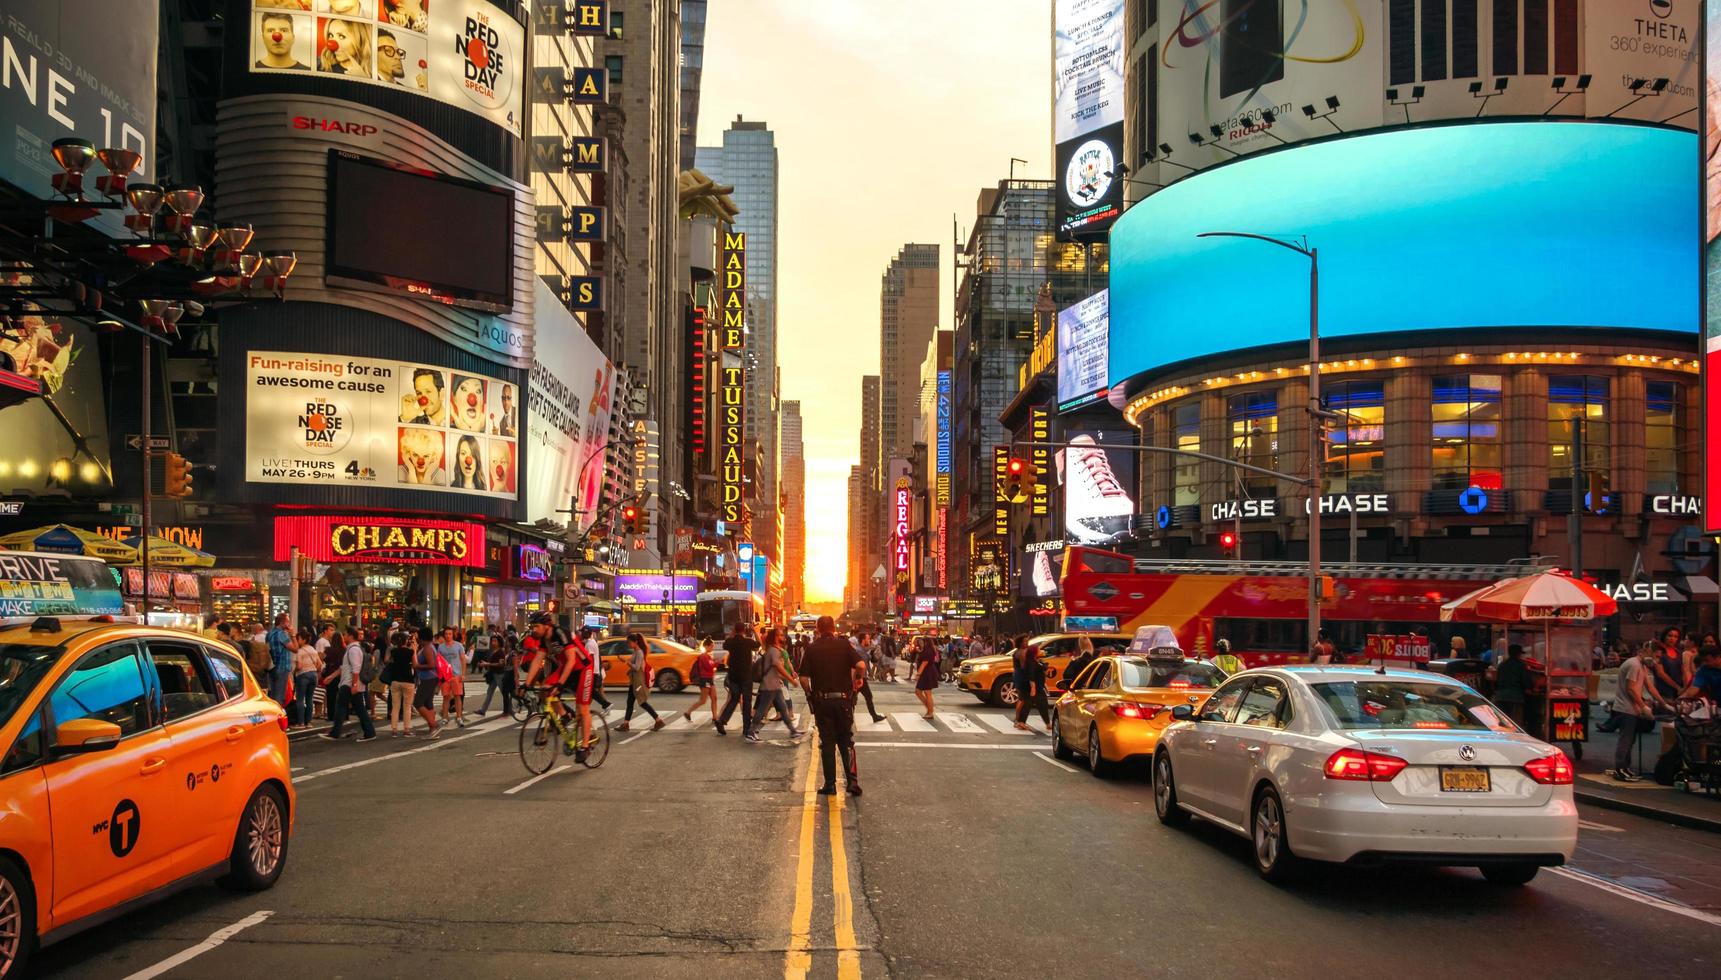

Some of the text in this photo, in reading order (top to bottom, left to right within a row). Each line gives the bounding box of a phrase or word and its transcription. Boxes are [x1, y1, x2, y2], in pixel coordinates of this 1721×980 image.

[477, 12, 489, 25] THE
[465, 16, 499, 49] RED
[1634, 19, 1687, 44] THETA
[464, 58, 497, 91] DAY
[76, 69, 98, 91] AND
[101, 84, 129, 113] IMAX
[465, 79, 495, 99] SPECIAL
[1087, 79, 1106, 92] MUSIC
[291, 116, 378, 137] SHARP
[506, 110, 514, 125] 4
[1230, 121, 1273, 141] RICOH
[101, 108, 146, 176] 10
[724, 233, 744, 347] MADAME
[482, 326, 522, 348] AQUOS
[250, 356, 391, 378] Fun-raising for an
[257, 375, 385, 393] awesome cause
[938, 371, 950, 393] NEW
[306, 403, 337, 417] RED
[542, 398, 561, 432] STORE
[305, 429, 336, 442] DAY
[723, 367, 744, 523] TUSSAUD'S
[938, 431, 950, 473] STUDIOS
[1033, 410, 1047, 514] NEW VICORY
[262, 459, 335, 470] LIVE! THURS
[262, 469, 335, 480] MAY 26 9PM
[345, 460, 359, 476] 4
[938, 477, 950, 501] DUKE
[1212, 499, 1276, 521] CHASE
[1653, 496, 1701, 514] CHA
[897, 490, 908, 569] REGAL
[996, 509, 1008, 535] NEW
[332, 525, 467, 559] CHAMPS
[1026, 540, 1063, 553] SKECHERS
[378, 550, 435, 559] SPORTS
[364, 575, 405, 587] CHAMPS
[0, 600, 35, 615] MAKE
[1564, 712, 1576, 727] 4
[1556, 723, 1584, 740] NUTS
[93, 820, 109, 835] NYC
